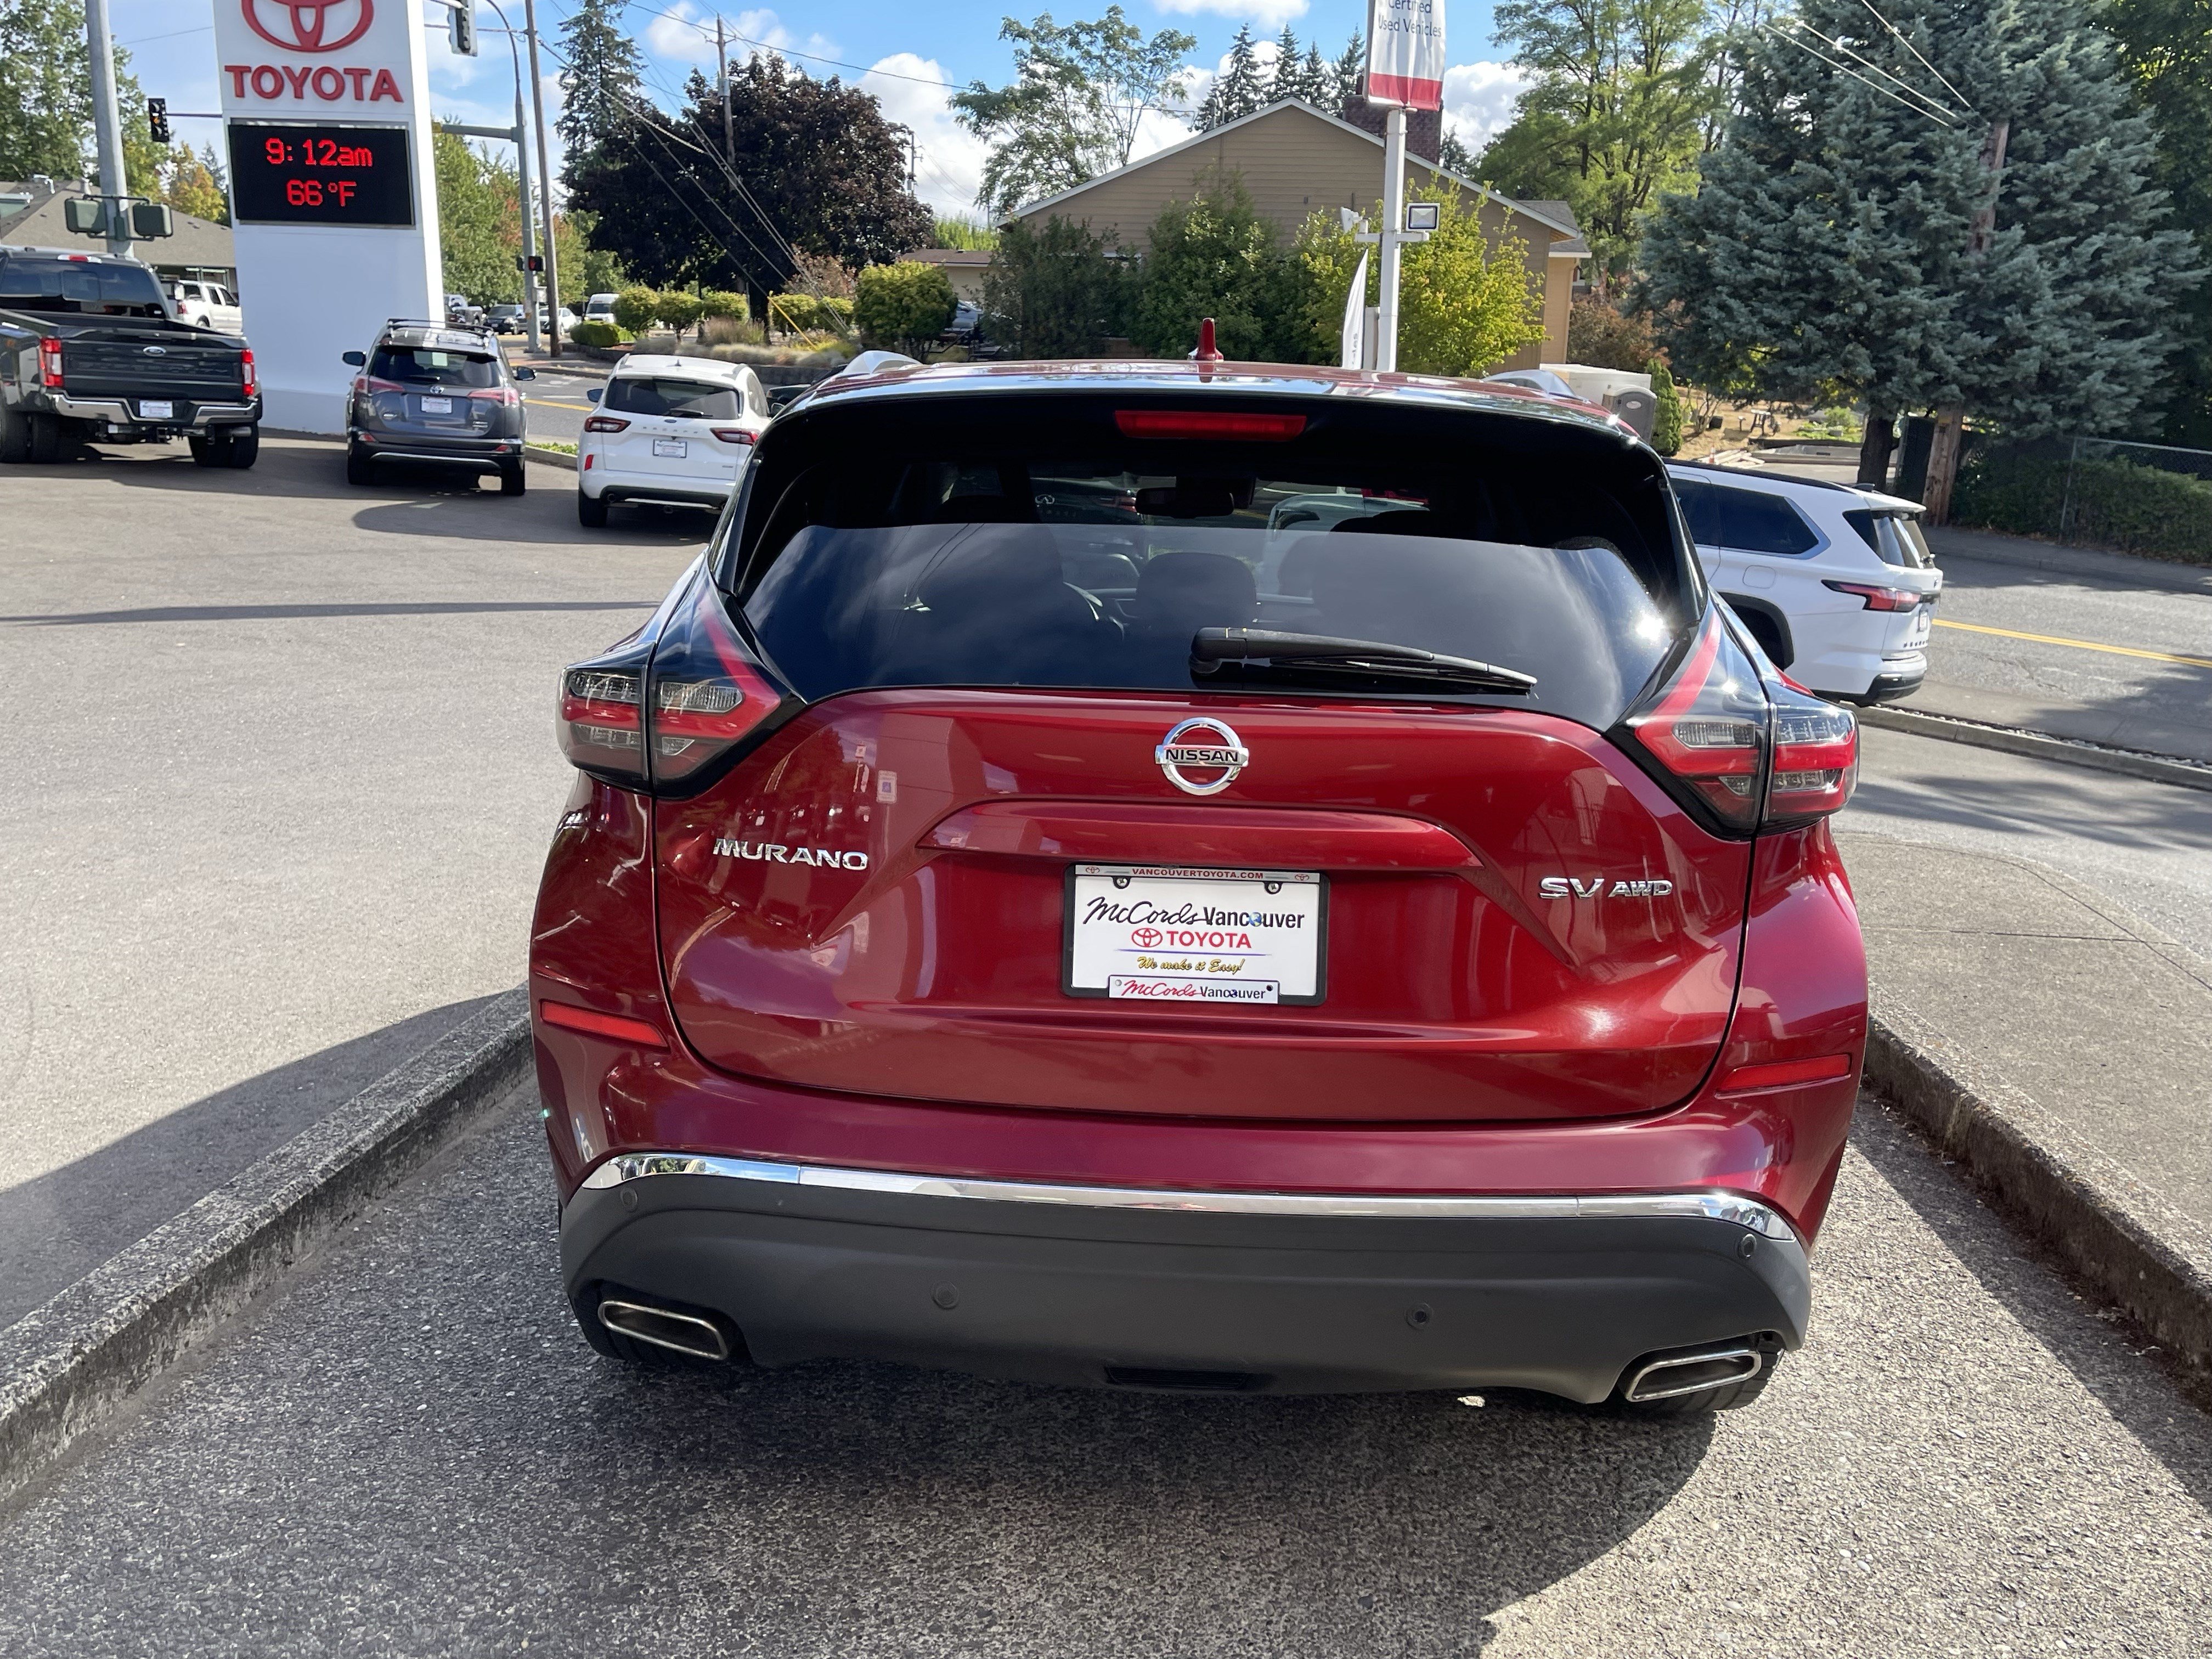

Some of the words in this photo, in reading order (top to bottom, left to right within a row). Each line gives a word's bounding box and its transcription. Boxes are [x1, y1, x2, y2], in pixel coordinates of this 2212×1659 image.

[1378, 13, 1401, 32] Used
[1403, 18, 1442, 37] Vehicles
[224, 64, 404, 103] TOYOTA
[1165, 749, 1239, 762] NISSAN
[712, 838, 869, 871] MURANO
[1132, 868, 1264, 879] VANCOUVERTOYOTA.COM
[1539, 877, 1605, 899] SV
[1608, 879, 1673, 898] AWD
[1166, 930, 1252, 949] TOYOTA
[1137, 956, 1158, 969] We
[1160, 958, 1193, 970] make
[1194, 961, 1206, 971] it
[1208, 958, 1246, 975] Easy!
